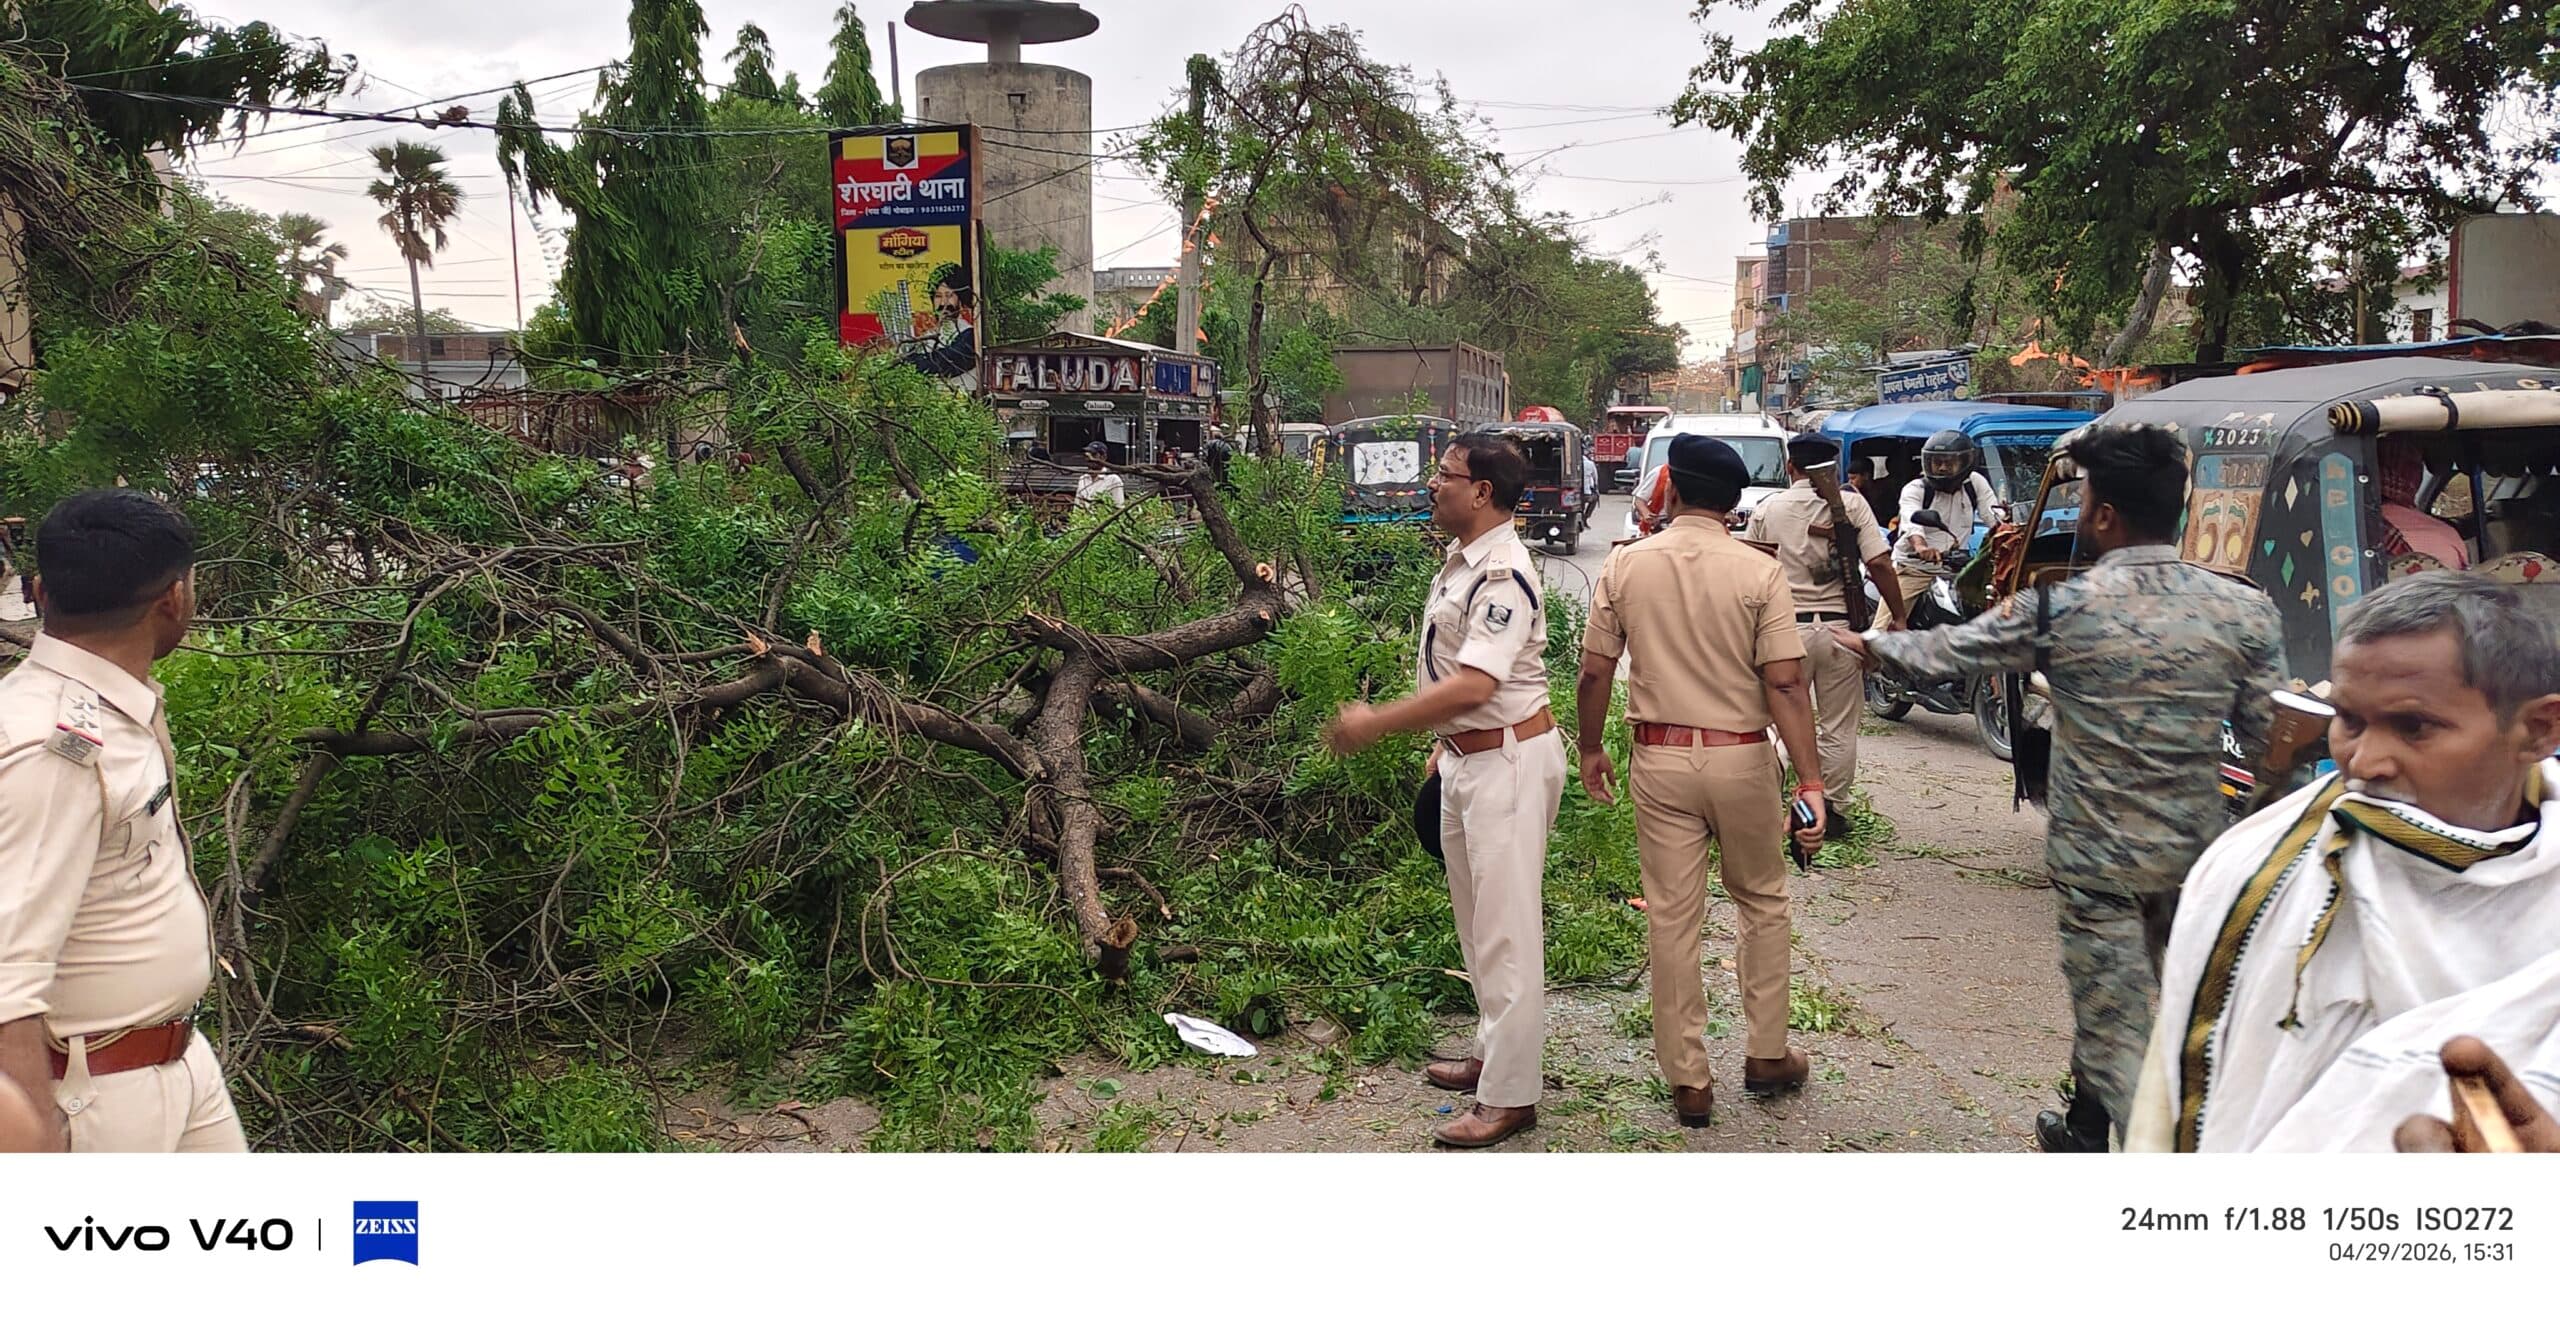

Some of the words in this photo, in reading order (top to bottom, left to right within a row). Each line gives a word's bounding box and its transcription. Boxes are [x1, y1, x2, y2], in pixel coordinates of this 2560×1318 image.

[837, 173, 912, 203] शेरघाटी
[918, 178, 965, 199] थाना
[995, 355, 1139, 392] FALUDA
[2215, 428, 2261, 446] 2023
